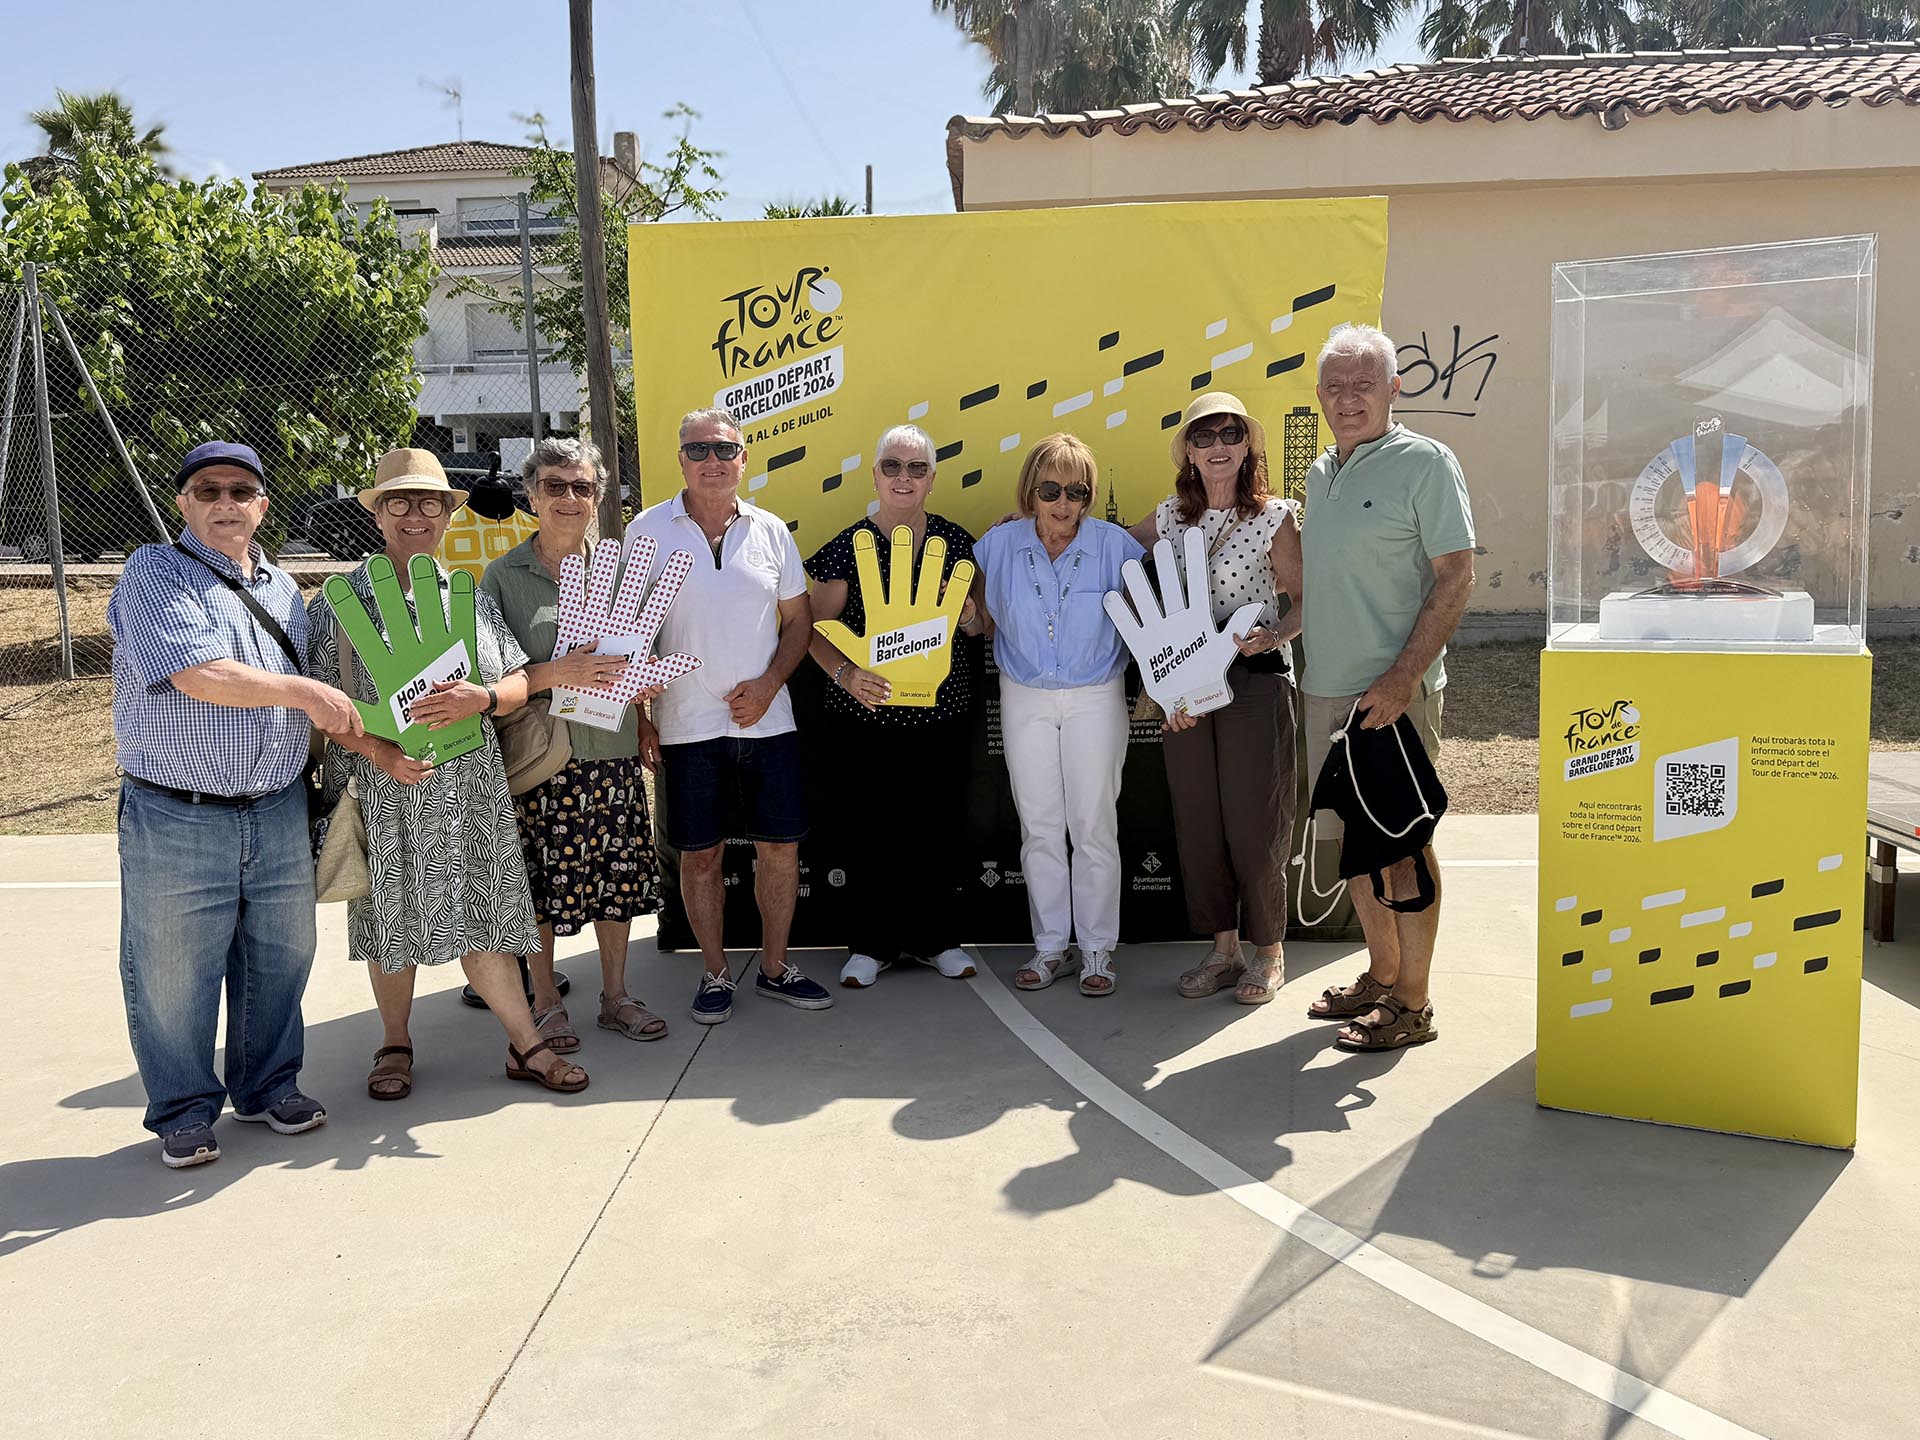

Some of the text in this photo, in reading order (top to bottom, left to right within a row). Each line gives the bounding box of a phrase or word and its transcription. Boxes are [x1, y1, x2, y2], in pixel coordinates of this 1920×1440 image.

[793, 309, 811, 325] de
[725, 355, 831, 407] GRAND DÉPART
[730, 372, 835, 421] ARCELONE 2026
[746, 406, 833, 444] 4 AL 6 DE JULIOL
[876, 633, 942, 662] Barcelona!
[877, 632, 905, 649] Hola
[1149, 645, 1174, 670] Hola
[1153, 631, 1208, 684] Barcelona!
[396, 679, 428, 709] Hola
[1193, 693, 1220, 706] Barcelona
[1611, 720, 1623, 730] de
[1752, 736, 1836, 746] Aquí trobaràs tota la
[1570, 745, 1633, 768] GRAND DÉPART
[1751, 747, 1830, 757] informació sobre el
[1568, 754, 1635, 778] BARCELONE 2026
[1751, 758, 1820, 768] Grand Départ del
[1752, 769, 1769, 777] Tour
[1771, 769, 1781, 777] de
[1819, 771, 1840, 780] 2026.
[1597, 803, 1642, 811] encontrarás
[1570, 811, 1587, 819] toda
[1596, 812, 1642, 822] información
[1562, 821, 1642, 833] sobre el Grand Départ
[1562, 831, 1578, 839] Tour
[1580, 832, 1590, 840] de
[1623, 835, 1642, 843] 2026.
[1132, 876, 1172, 885] Ajuntament
